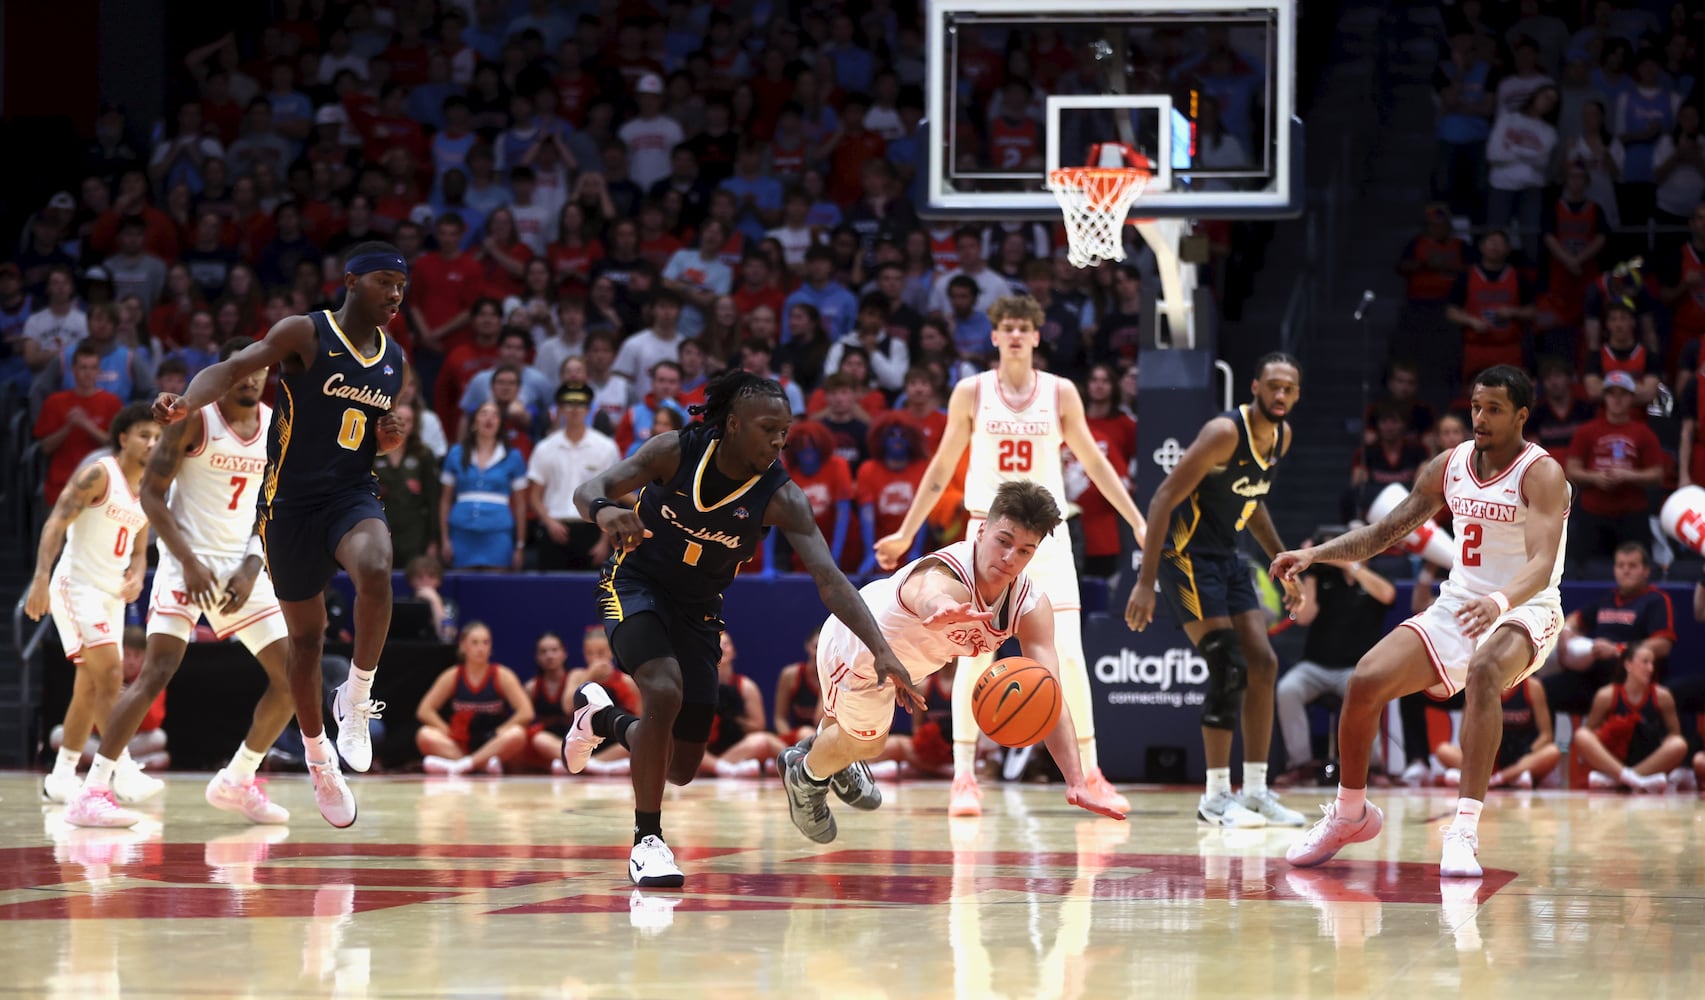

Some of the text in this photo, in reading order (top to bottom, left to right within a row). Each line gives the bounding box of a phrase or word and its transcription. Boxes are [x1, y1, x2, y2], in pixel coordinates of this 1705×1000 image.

[323, 373, 392, 410] Canisius
[337, 407, 367, 451] 0
[986, 420, 1049, 436] DAYTON
[211, 454, 267, 475] DAYTO
[998, 439, 1032, 472] 29
[228, 476, 247, 510] 7
[1451, 497, 1517, 522] DAYTON
[114, 526, 128, 557] 0
[682, 539, 703, 567] 1
[1462, 523, 1483, 567] 2
[1095, 648, 1210, 691] altafib
[1107, 691, 1183, 708] connecting
